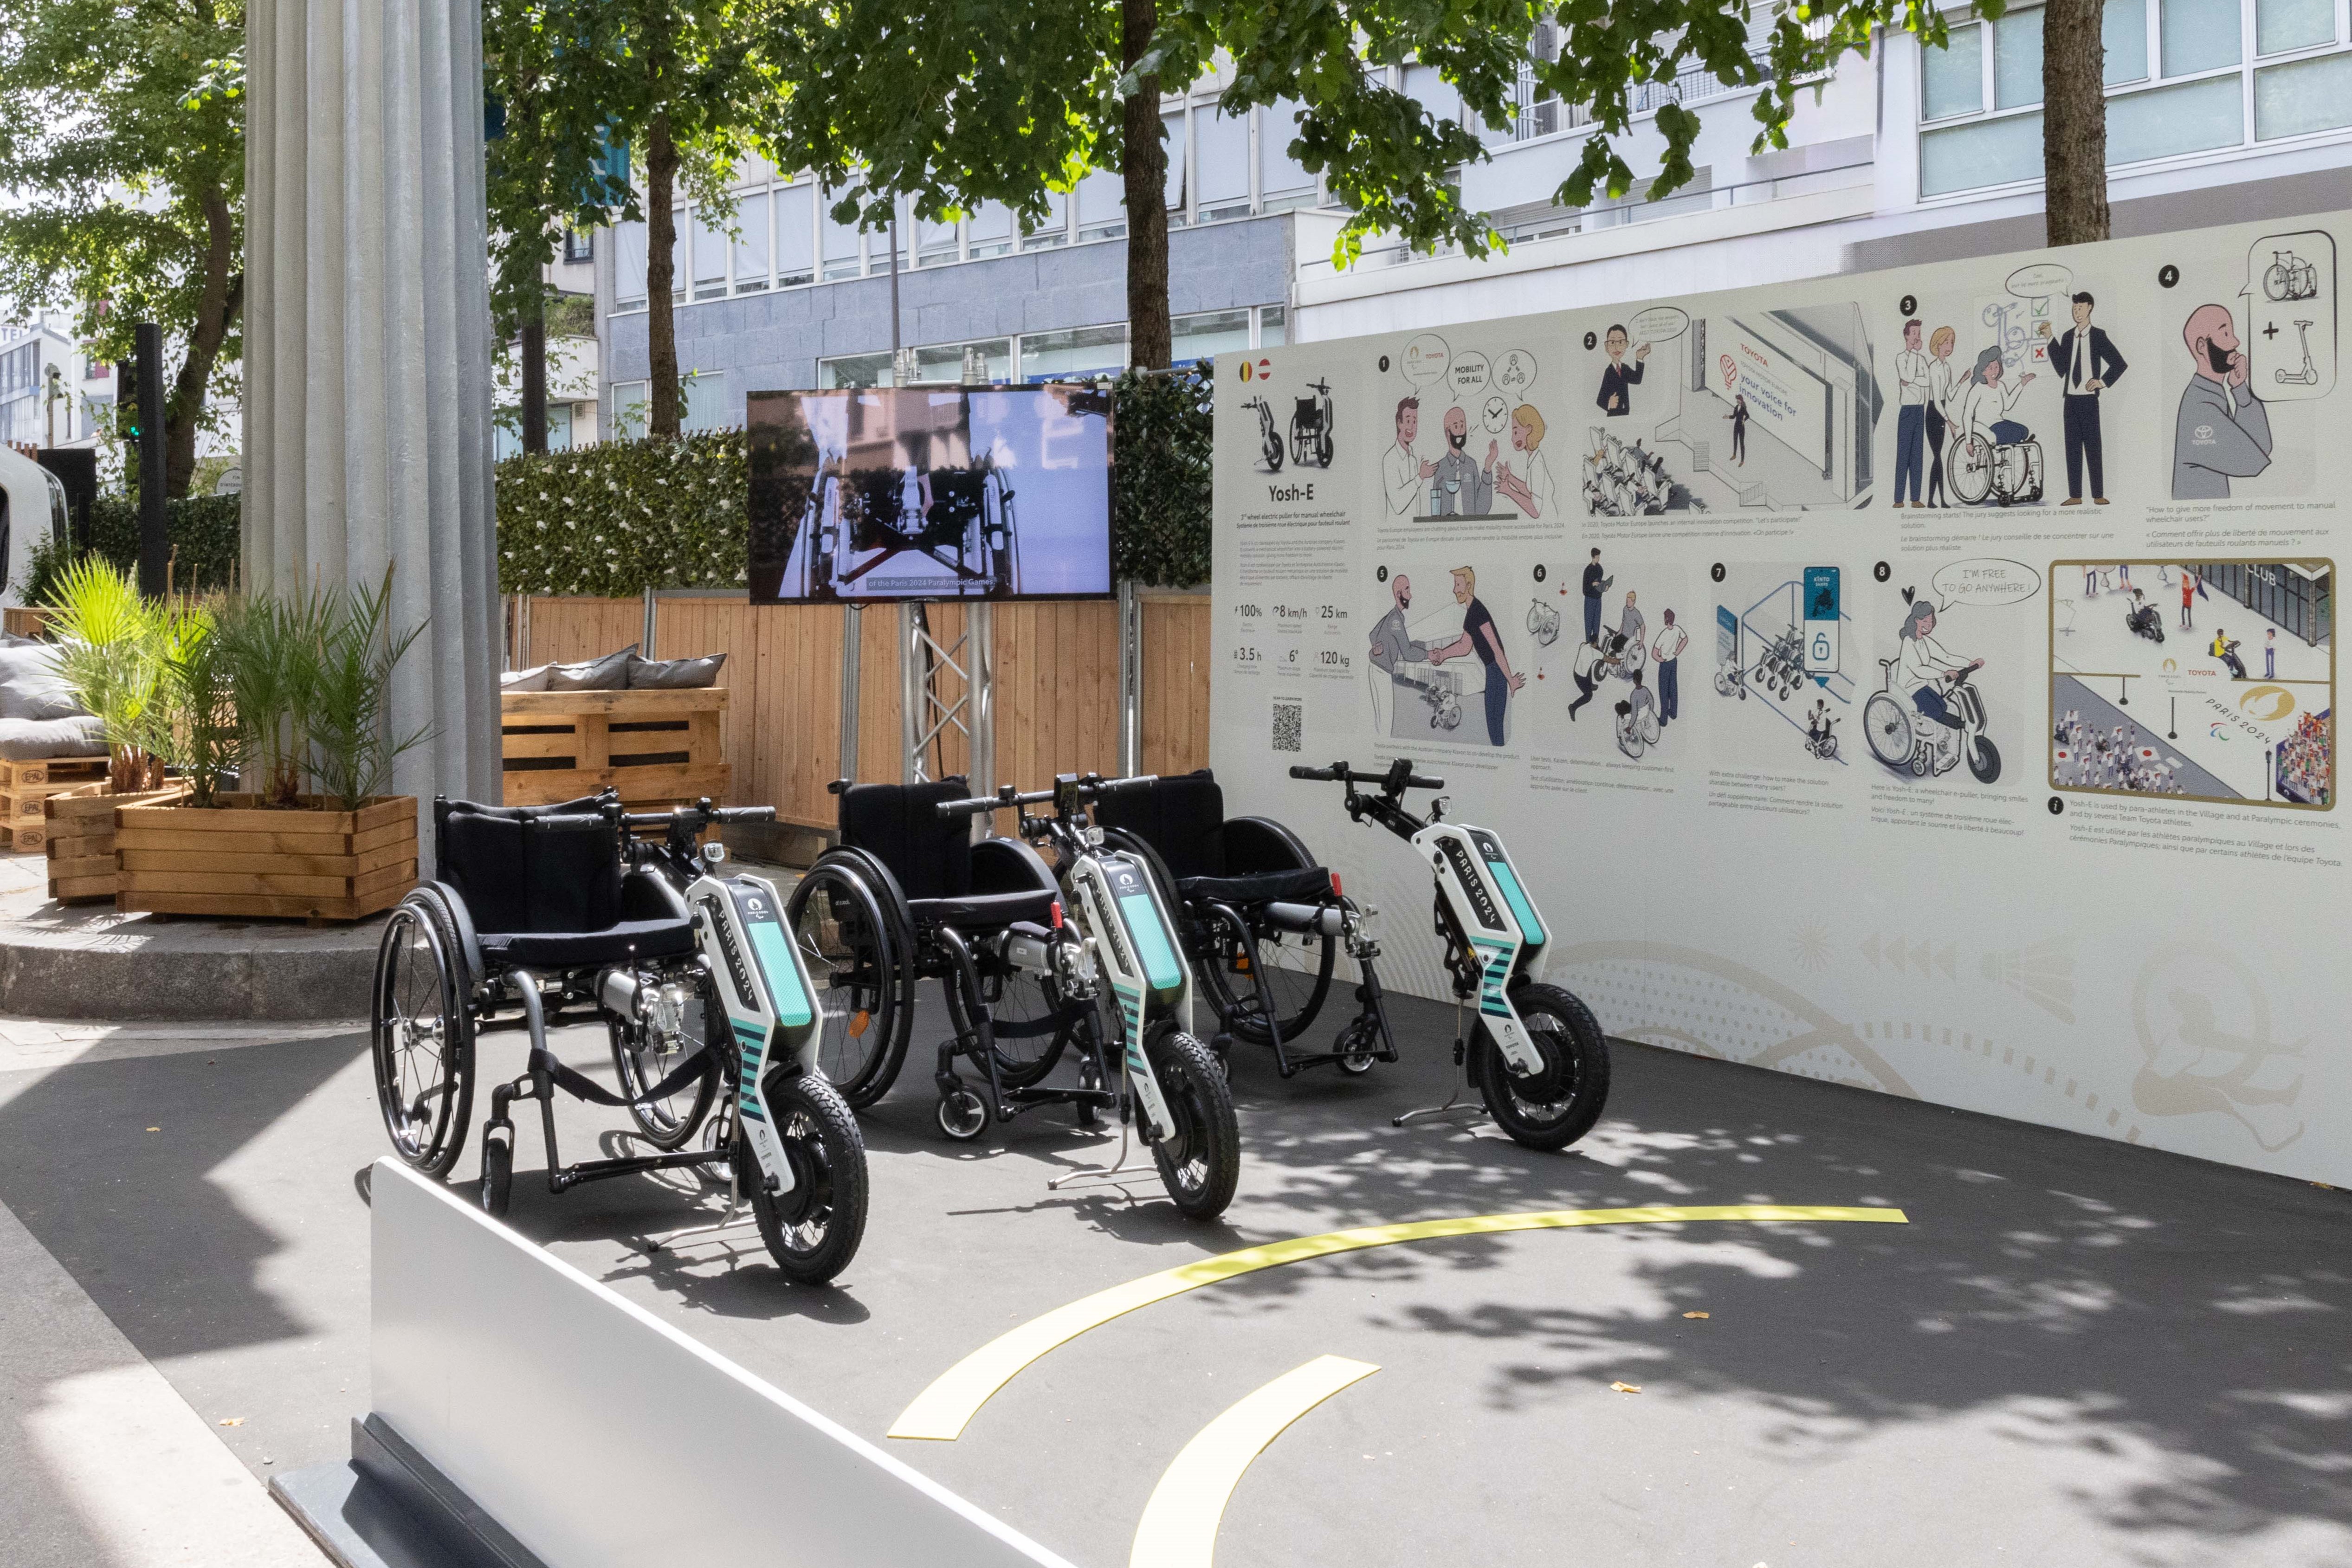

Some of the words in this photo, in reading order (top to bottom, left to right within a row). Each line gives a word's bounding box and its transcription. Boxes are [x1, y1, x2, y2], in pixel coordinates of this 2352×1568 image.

[2165, 271, 2172, 281] 4
[1905, 301, 1912, 310] 3
[1587, 336, 1592, 345] 2
[1740, 343, 1768, 367] TOYOTA
[1455, 364, 1484, 374] MOBILITY
[1741, 373, 1759, 390] your
[1761, 387, 1782, 407] voice
[1784, 401, 1796, 416] for
[1739, 383, 1783, 421] innovation
[1269, 484, 1314, 502] Yosh-E
[1279, 512, 1292, 521] puller
[1537, 568, 1542, 577] 6
[1716, 568, 1721, 577] 7
[1880, 567, 1885, 576] 8
[1963, 570, 1979, 579] I'M
[1982, 569, 2006, 579] FREE
[1942, 583, 1956, 592] TO
[1958, 583, 1973, 594] GO
[1240, 605, 1262, 617] 100%
[1280, 605, 1286, 617] 8
[1288, 607, 1307, 619] km/h
[1321, 606, 1333, 618] 25
[1336, 608, 1347, 619] km
[1240, 647, 1254, 660] 3.5
[1257, 652, 1261, 661] h
[1289, 650, 1299, 662] 6°
[1321, 652, 1338, 664] 120
[1340, 655, 1350, 667] kg
[2205, 698, 2240, 722] PARIS
[2239, 722, 2271, 744] 2024
[1981, 793, 2007, 802] bringing
[2129, 806, 2176, 815] para-athletes
[2200, 811, 2224, 820] Village
[2251, 814, 2293, 825] Paralympic
[2139, 816, 2161, 825] Toyota
[2163, 818, 2194, 827] athletes.
[2070, 824, 2092, 832] Yosh-E
[2106, 827, 2126, 835] utilisé
[2182, 834, 2235, 846] paralympiques
[2248, 840, 2273, 849] Village
[2179, 845, 2194, 853] que
[2209, 848, 2237, 857] certains
[1456, 850, 1478, 887] PARIS
[1475, 889, 1495, 923] 2024
[719, 910, 737, 955] PARIS
[735, 958, 753, 1000] 2024
